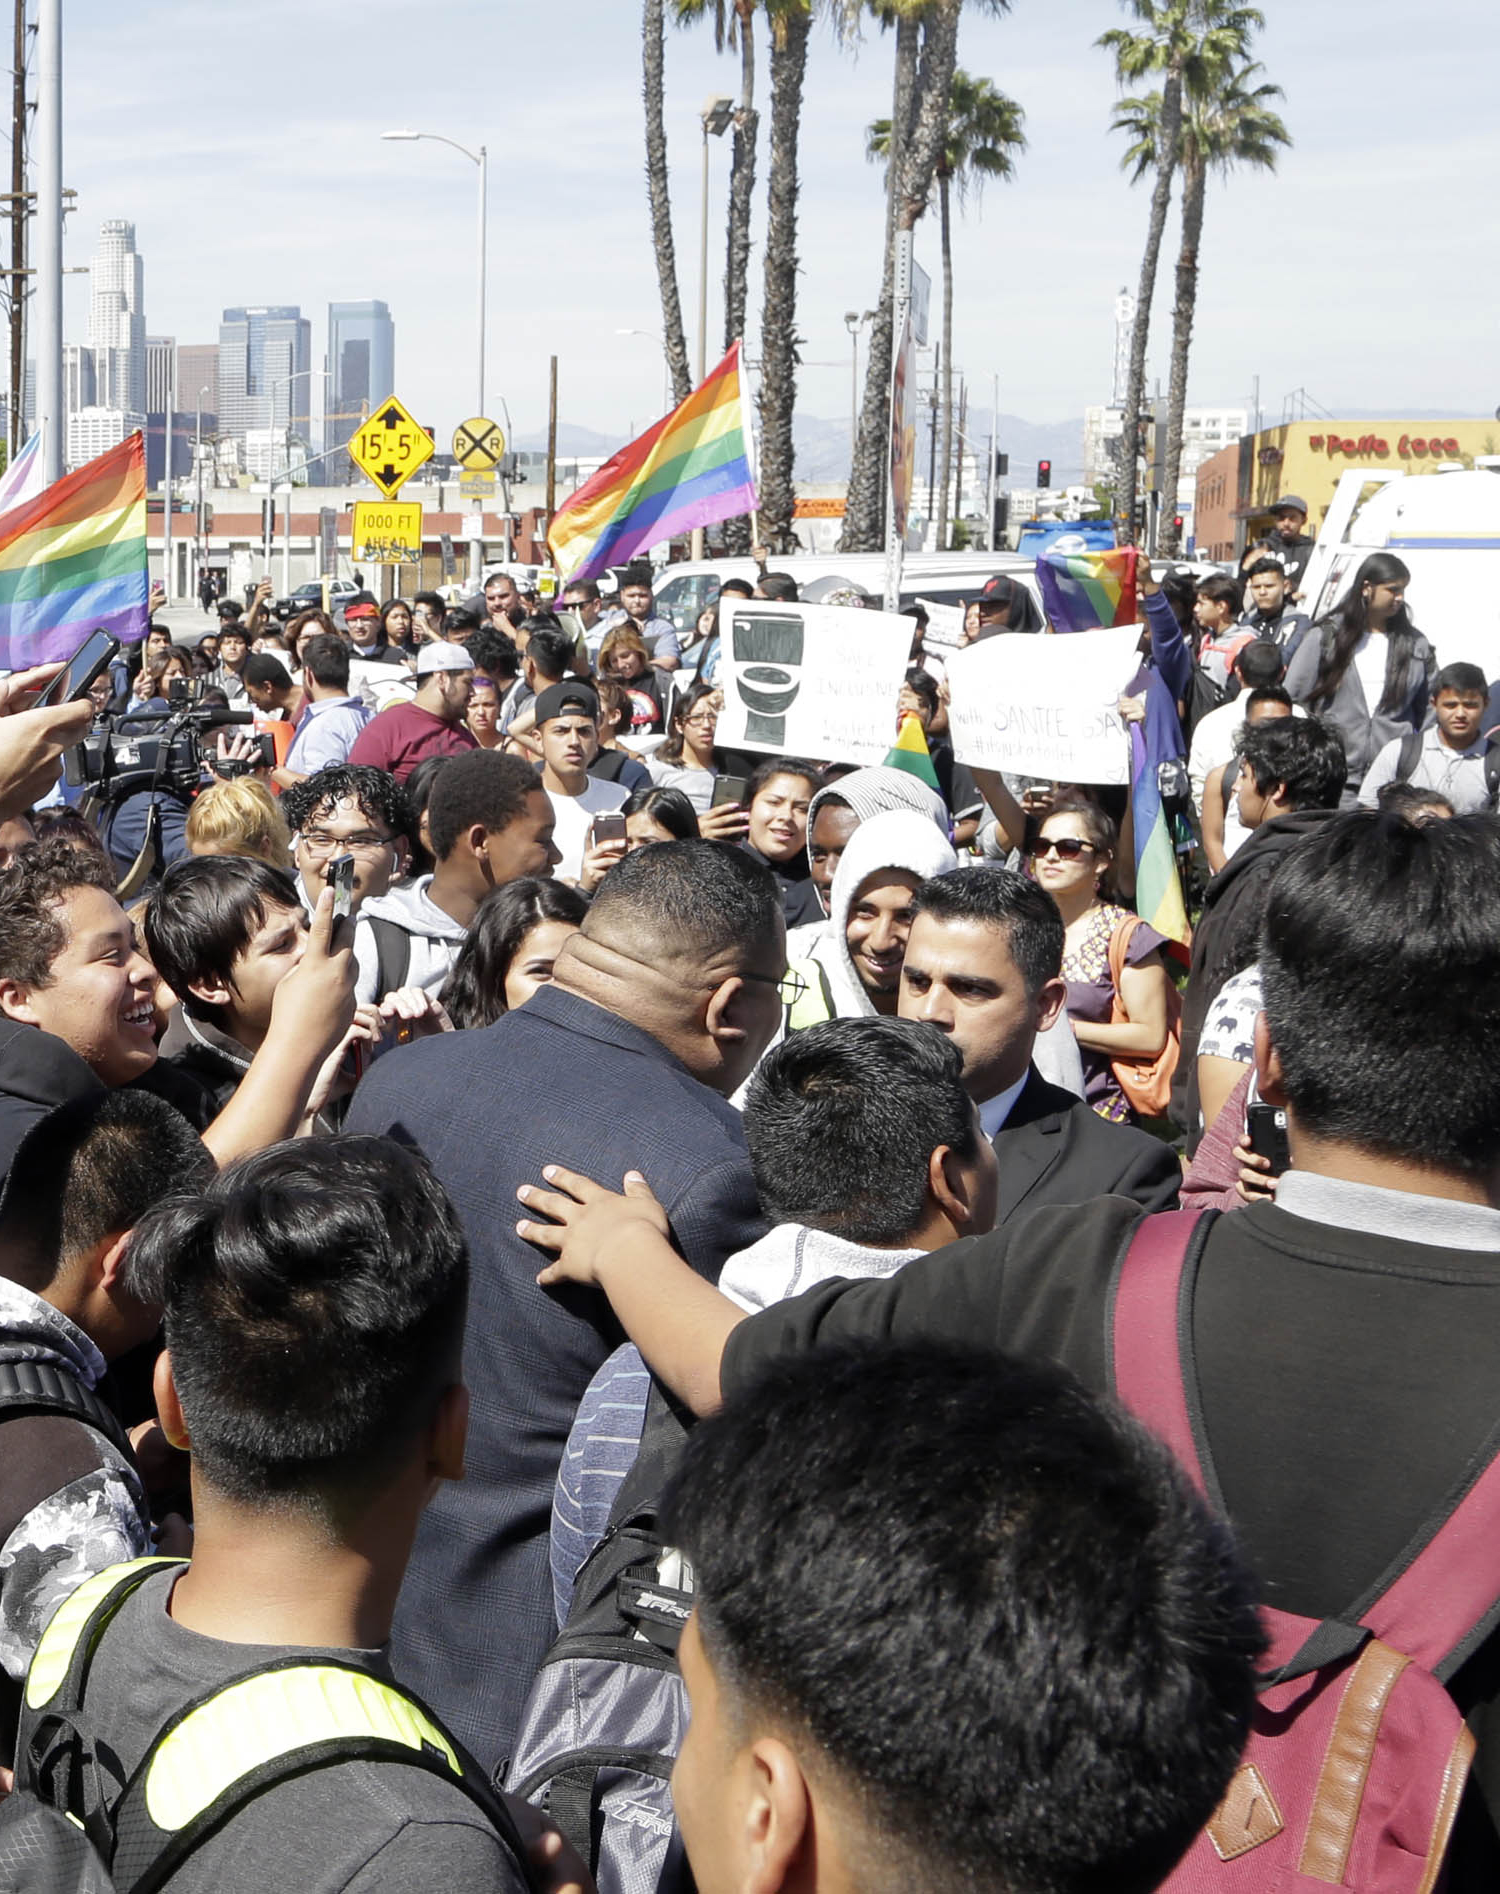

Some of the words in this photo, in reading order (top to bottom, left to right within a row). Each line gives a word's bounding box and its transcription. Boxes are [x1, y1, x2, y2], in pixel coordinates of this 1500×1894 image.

[456, 438, 466, 450] R
[490, 438, 501, 450] R
[363, 514, 393, 529] 1000
[398, 514, 413, 529] FT
[994, 702, 1069, 738] SANTEE
